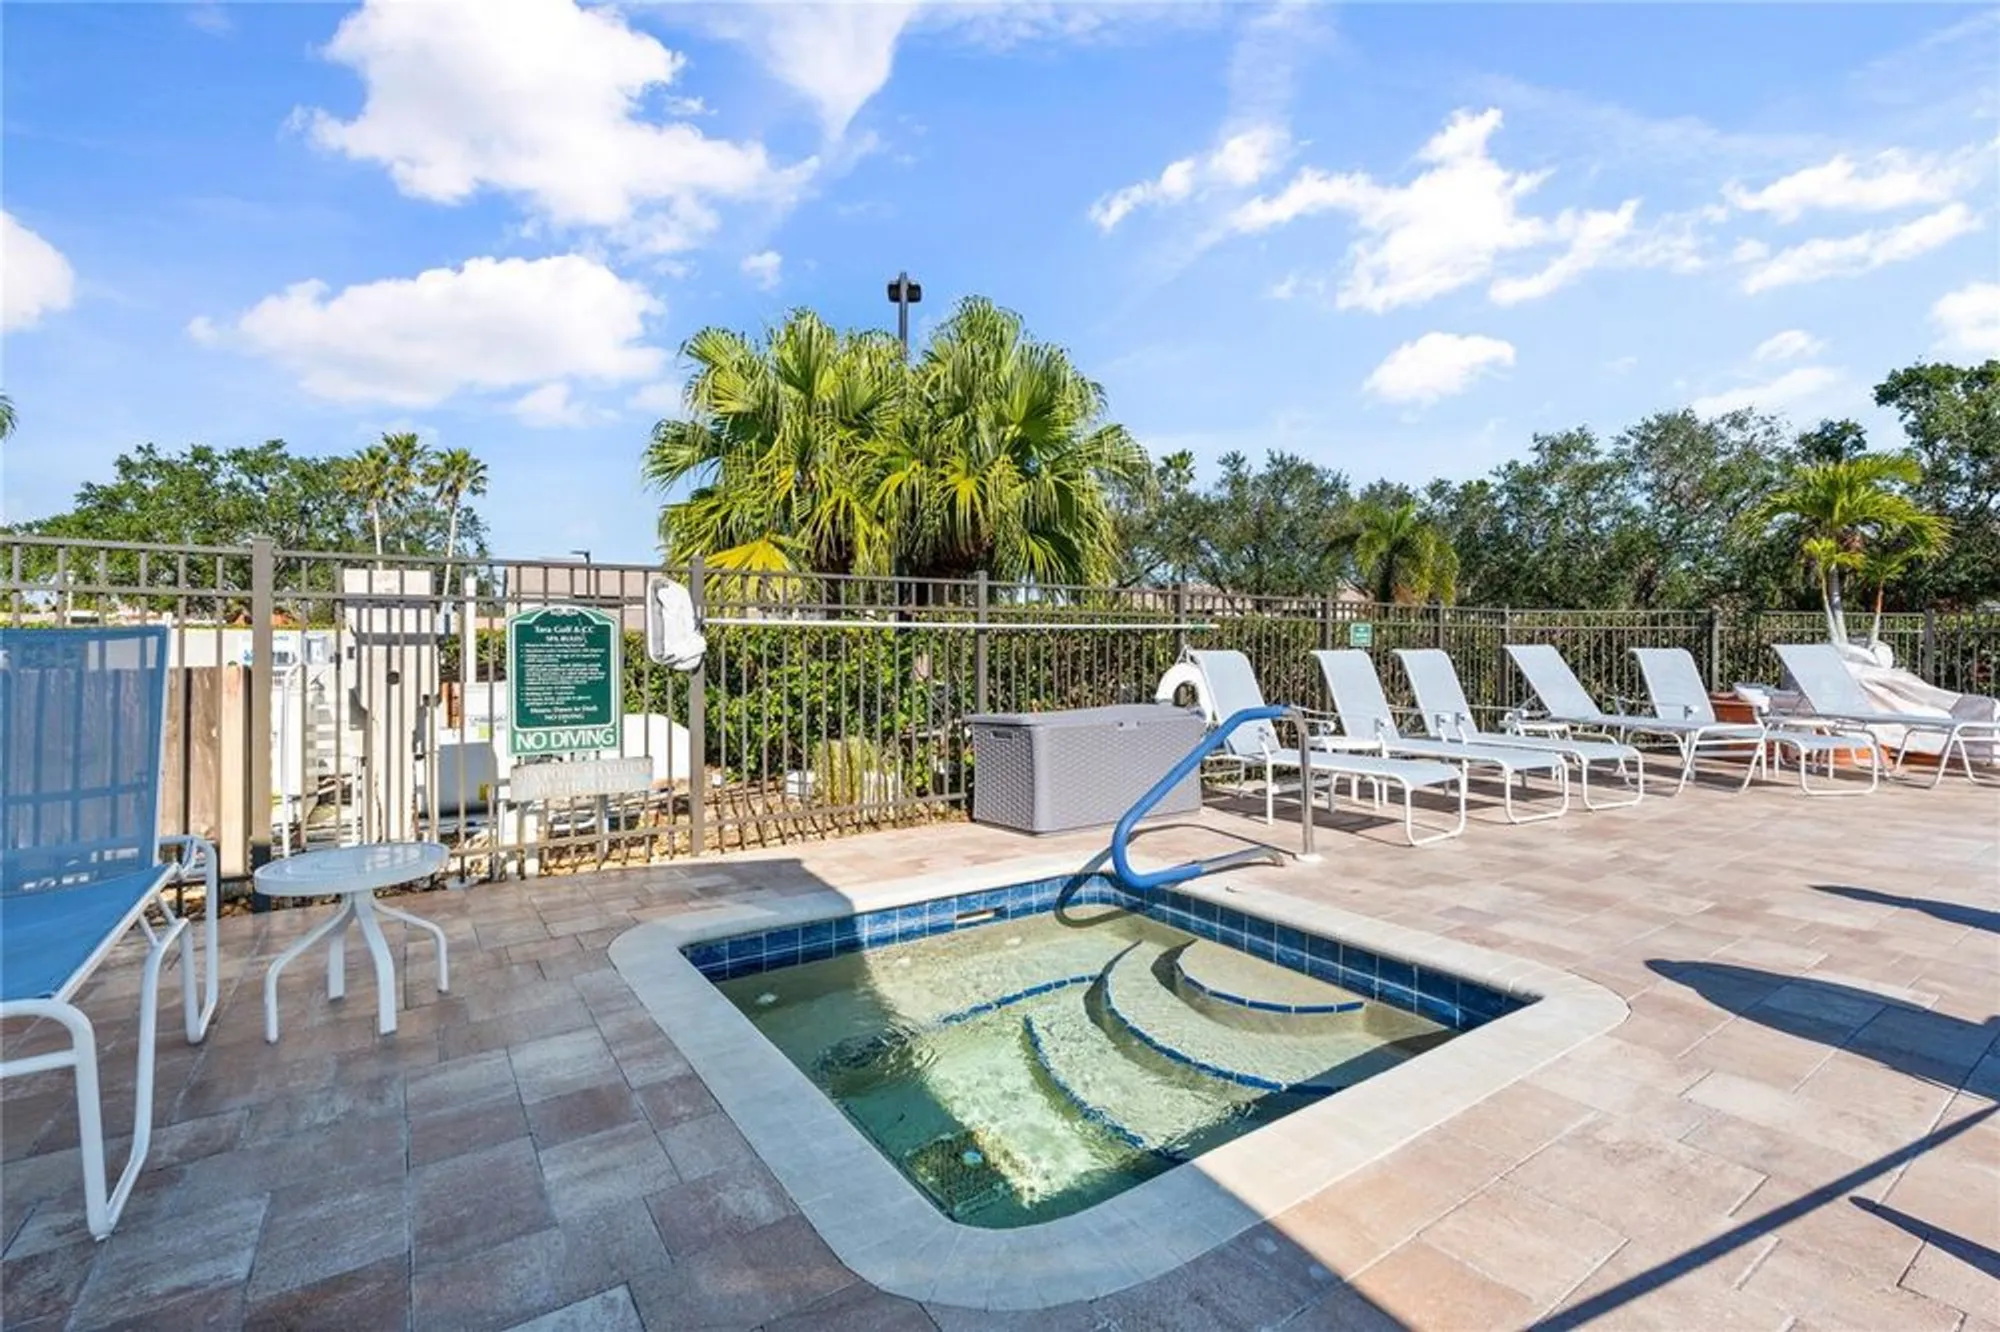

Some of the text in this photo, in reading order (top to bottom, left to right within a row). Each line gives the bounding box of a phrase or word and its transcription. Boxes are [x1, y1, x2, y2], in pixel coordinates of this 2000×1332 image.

[534, 625, 552, 633] Tara
[554, 624, 572, 633] Golf
[582, 625, 594, 633] CC
[516, 728, 615, 750] NO DIVING
